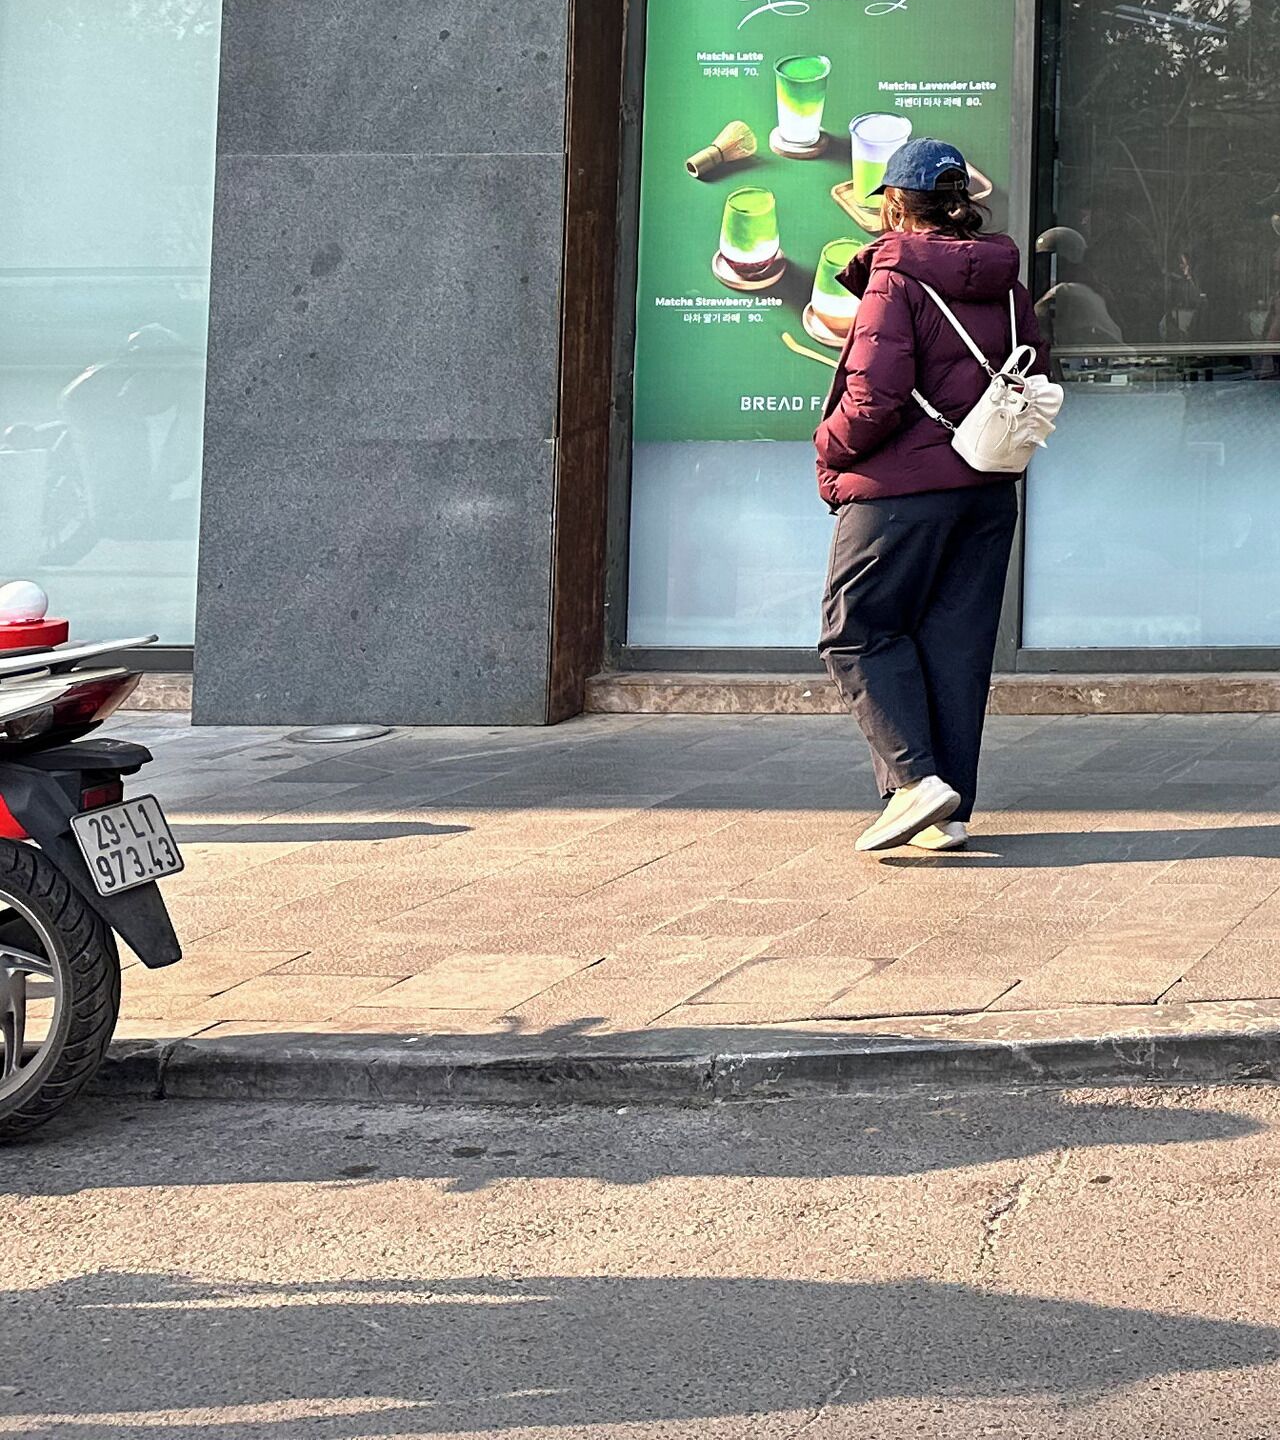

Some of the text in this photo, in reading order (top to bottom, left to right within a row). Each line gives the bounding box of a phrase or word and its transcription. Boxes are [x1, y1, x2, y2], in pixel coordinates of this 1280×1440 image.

[696, 51, 764, 61] Matcha Latte
[878, 81, 997, 90] Matcha Lavender Latte
[655, 297, 783, 308] Matcha Strawberry Latte
[740, 396, 803, 411] BREAD
[88, 803, 155, 850] 29-L1
[95, 836, 177, 888] 973.43
